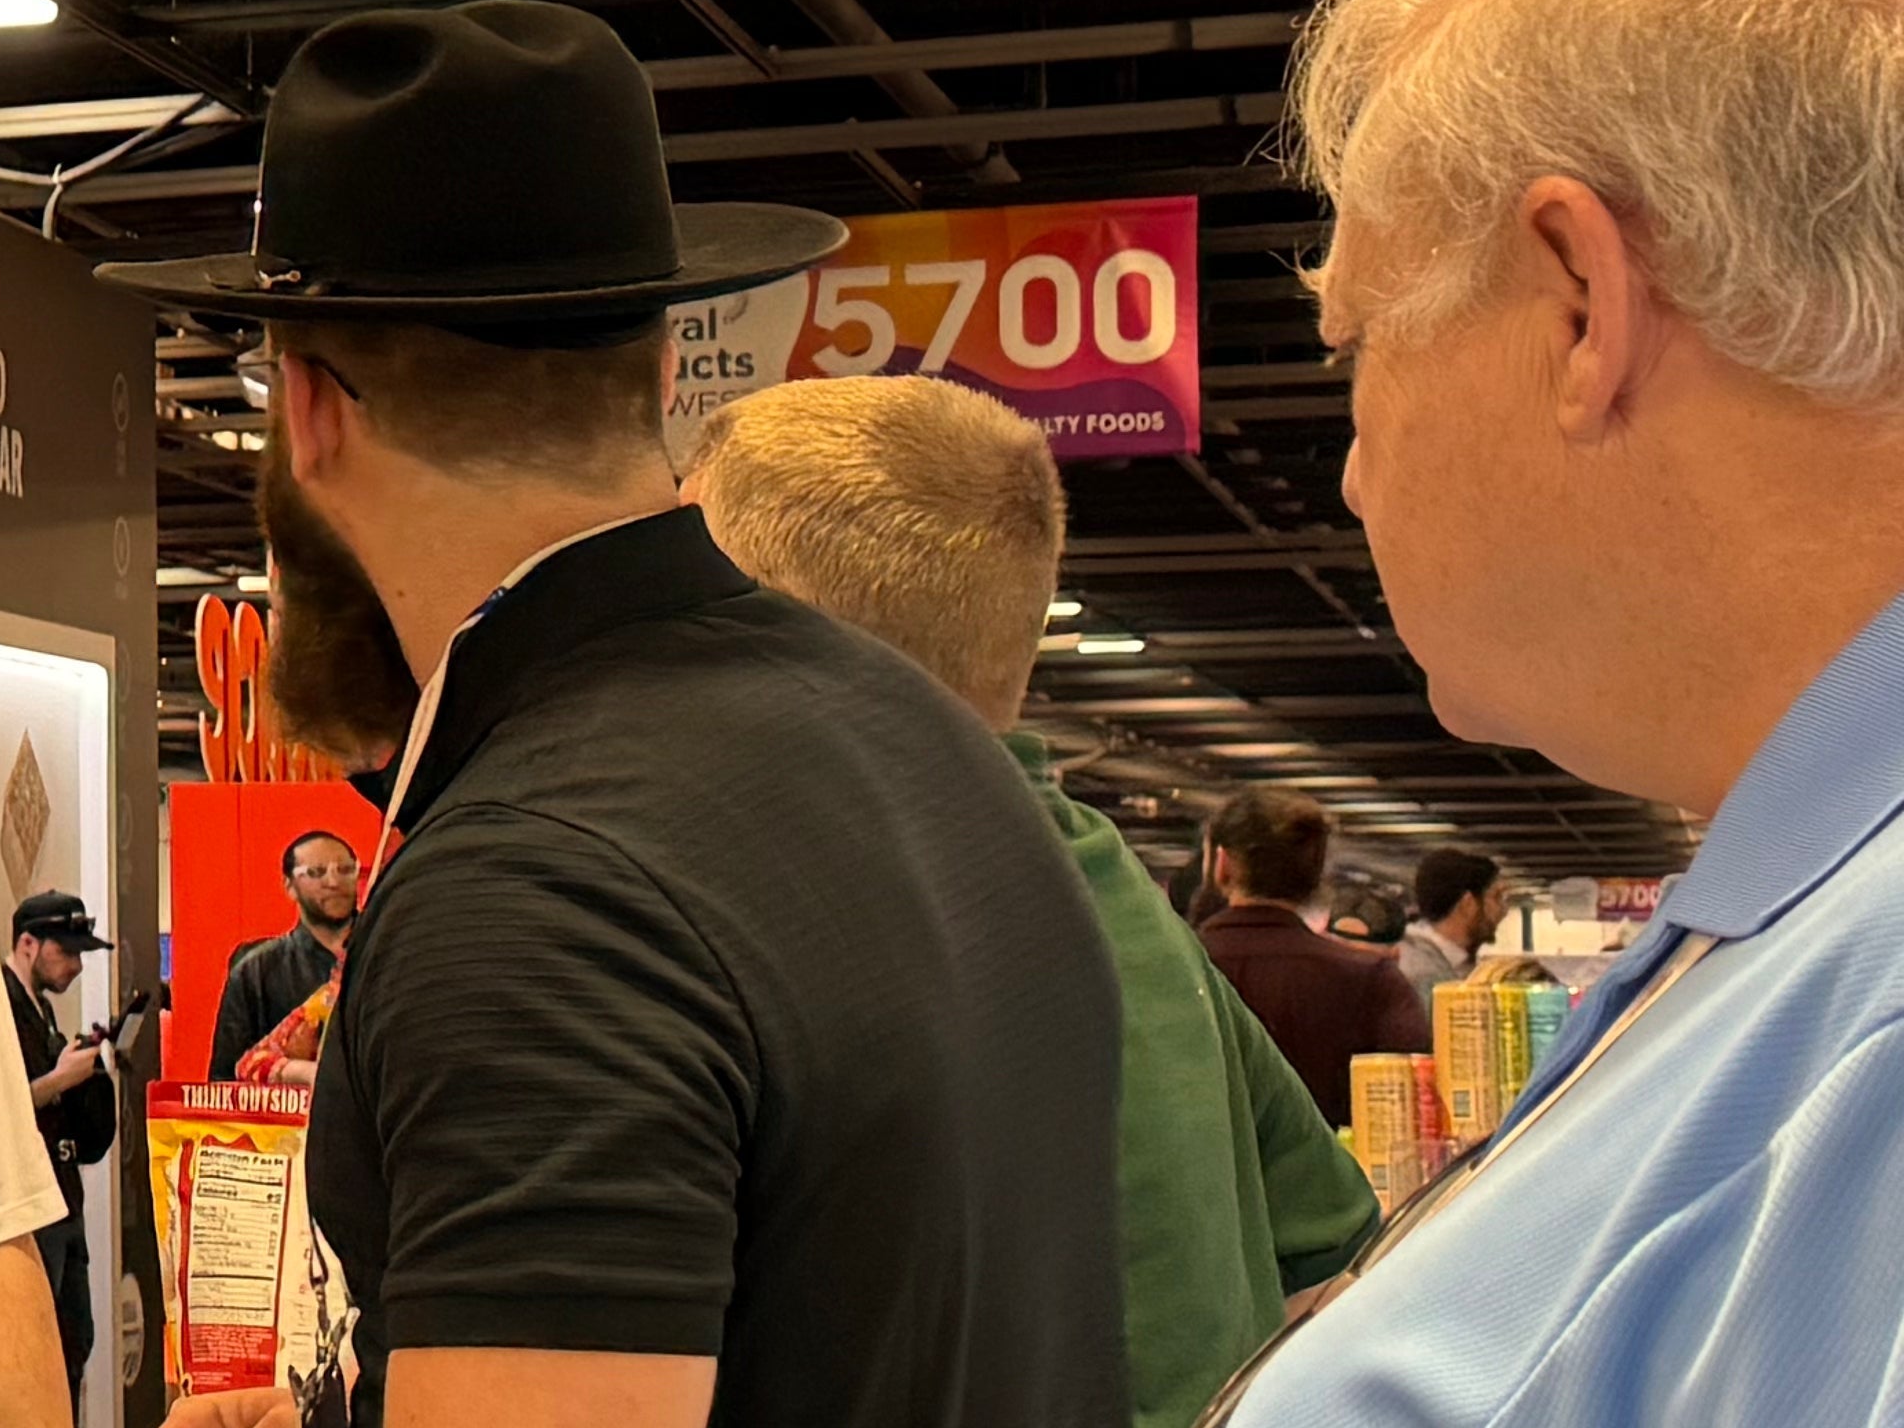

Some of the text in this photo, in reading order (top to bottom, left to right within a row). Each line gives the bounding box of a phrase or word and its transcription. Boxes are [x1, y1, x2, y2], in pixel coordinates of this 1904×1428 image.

[812, 249, 1176, 373] 5700
[1087, 411, 1165, 434] FOODS
[1600, 884, 1660, 909] 5700
[181, 1085, 310, 1115] THINK OUTSIDE
